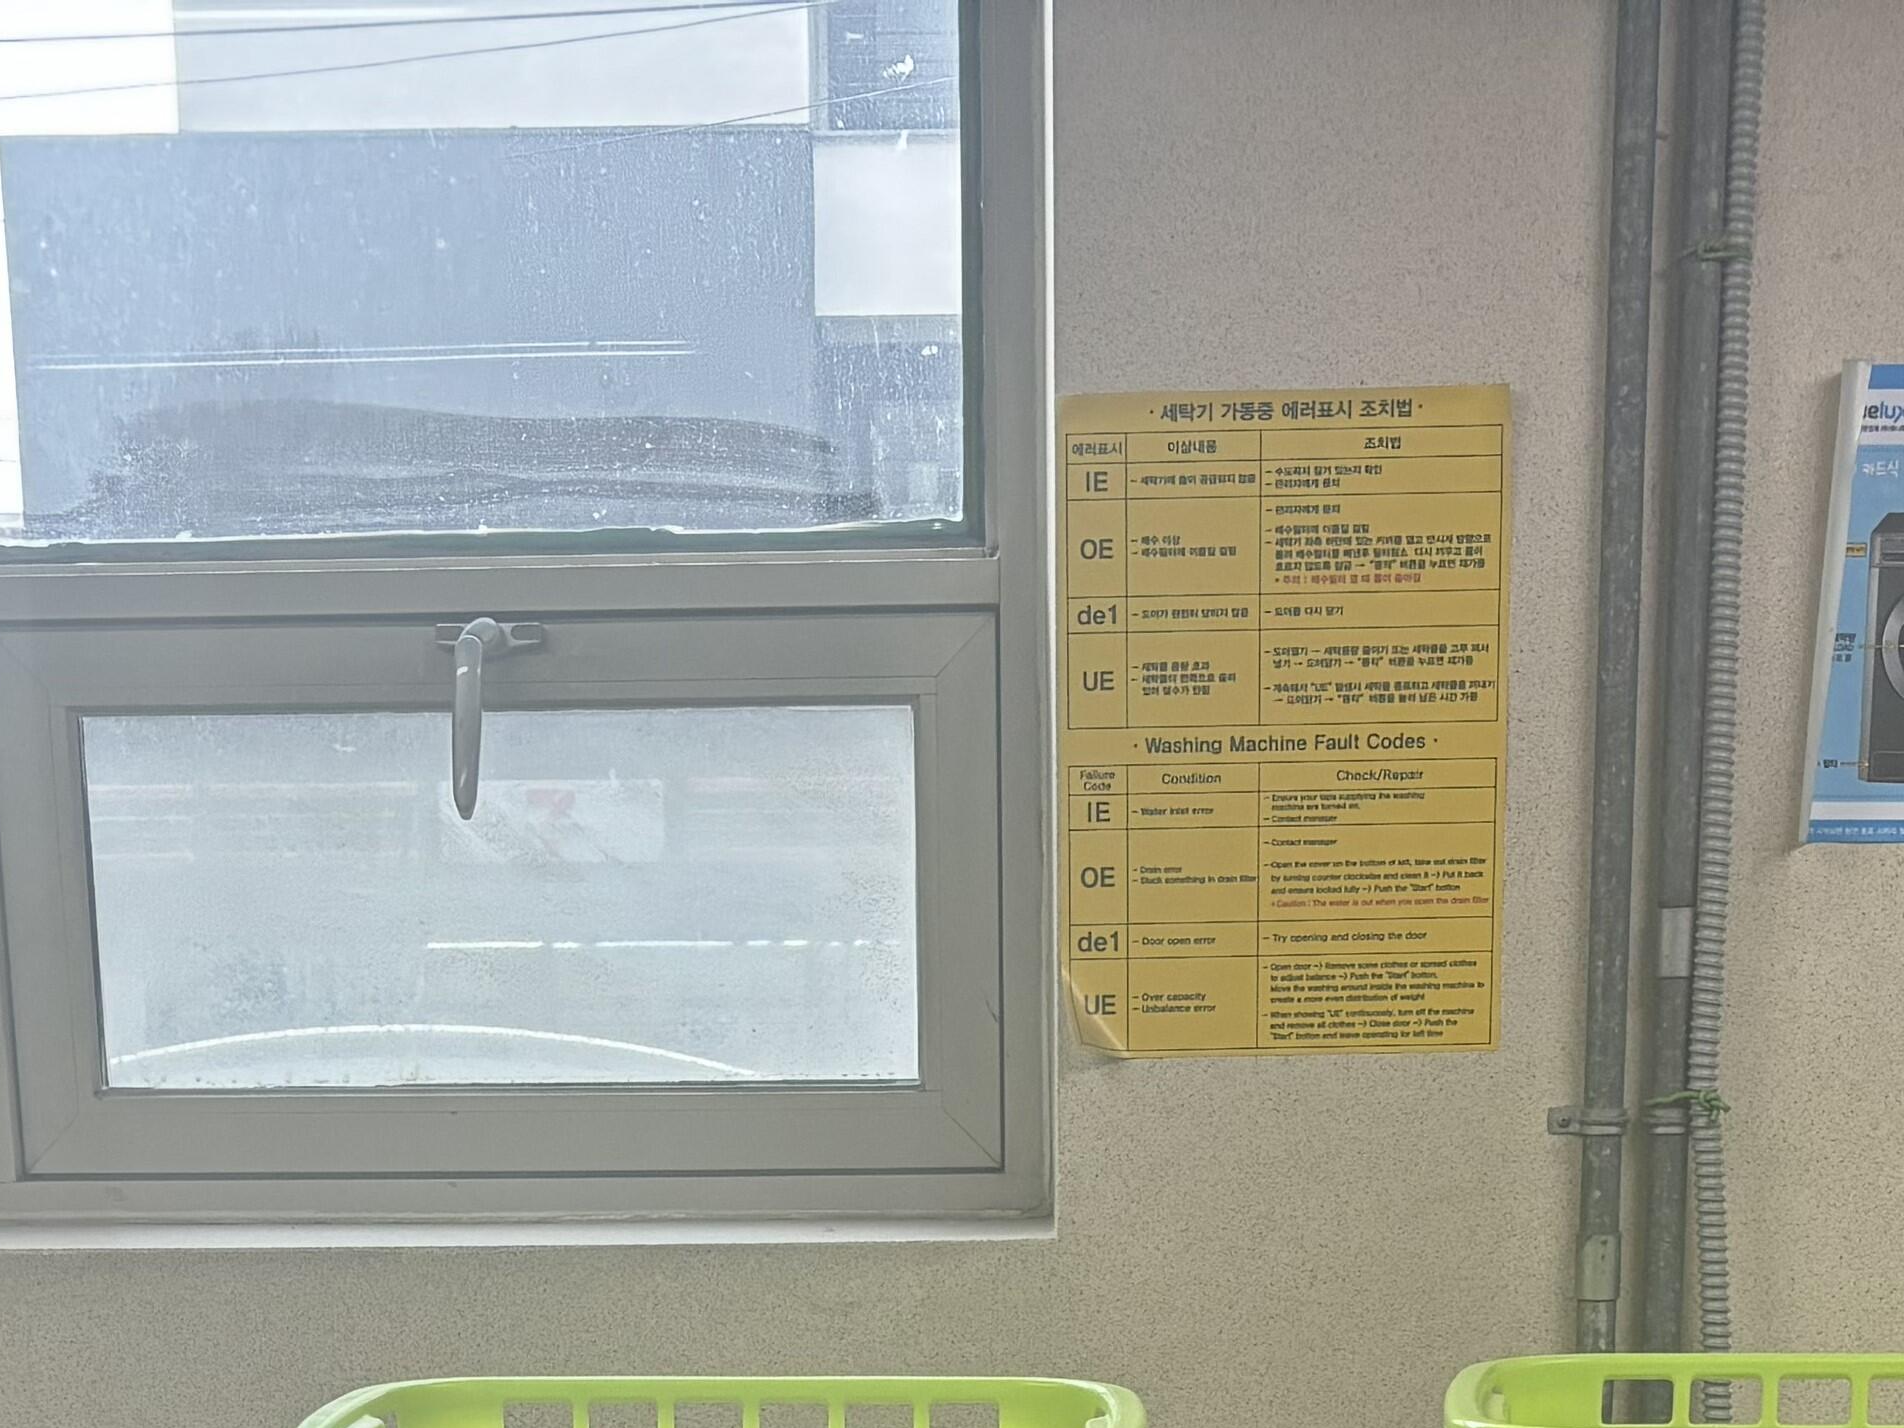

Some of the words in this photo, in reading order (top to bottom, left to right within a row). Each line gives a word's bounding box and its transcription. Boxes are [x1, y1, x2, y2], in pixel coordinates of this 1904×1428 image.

[1160, 401, 1213, 423] 세탁기
[1220, 401, 1275, 422] 가동중
[1281, 399, 1352, 421] 에러표시
[1358, 397, 1413, 418] 조치법
[1071, 441, 1123, 457] 에러표시
[1363, 435, 1402, 450] 조치법
[1085, 471, 1109, 493] IE
[1080, 538, 1115, 560] OE
[1077, 603, 1117, 626] de1
[1083, 670, 1115, 692] UE
[1144, 736, 1223, 755] Washing
[1229, 734, 1308, 753] Machine
[1314, 733, 1360, 751] Fault
[1366, 732, 1426, 750] Codes
[1079, 769, 1116, 783] Failure
[1083, 781, 1112, 791] Code
[1161, 772, 1222, 785] Condition
[1336, 768, 1424, 782] Check/Repair
[1087, 801, 1111, 823] IE
[1080, 866, 1116, 889] OE
[1077, 930, 1119, 953] de1
[1271, 933, 1288, 944] Try
[1290, 933, 1329, 943] opening
[1330, 932, 1350, 942] and
[1351, 931, 1386, 942] closing
[1387, 932, 1403, 940] the
[1404, 930, 1428, 940] door
[1084, 994, 1117, 1016] UE
